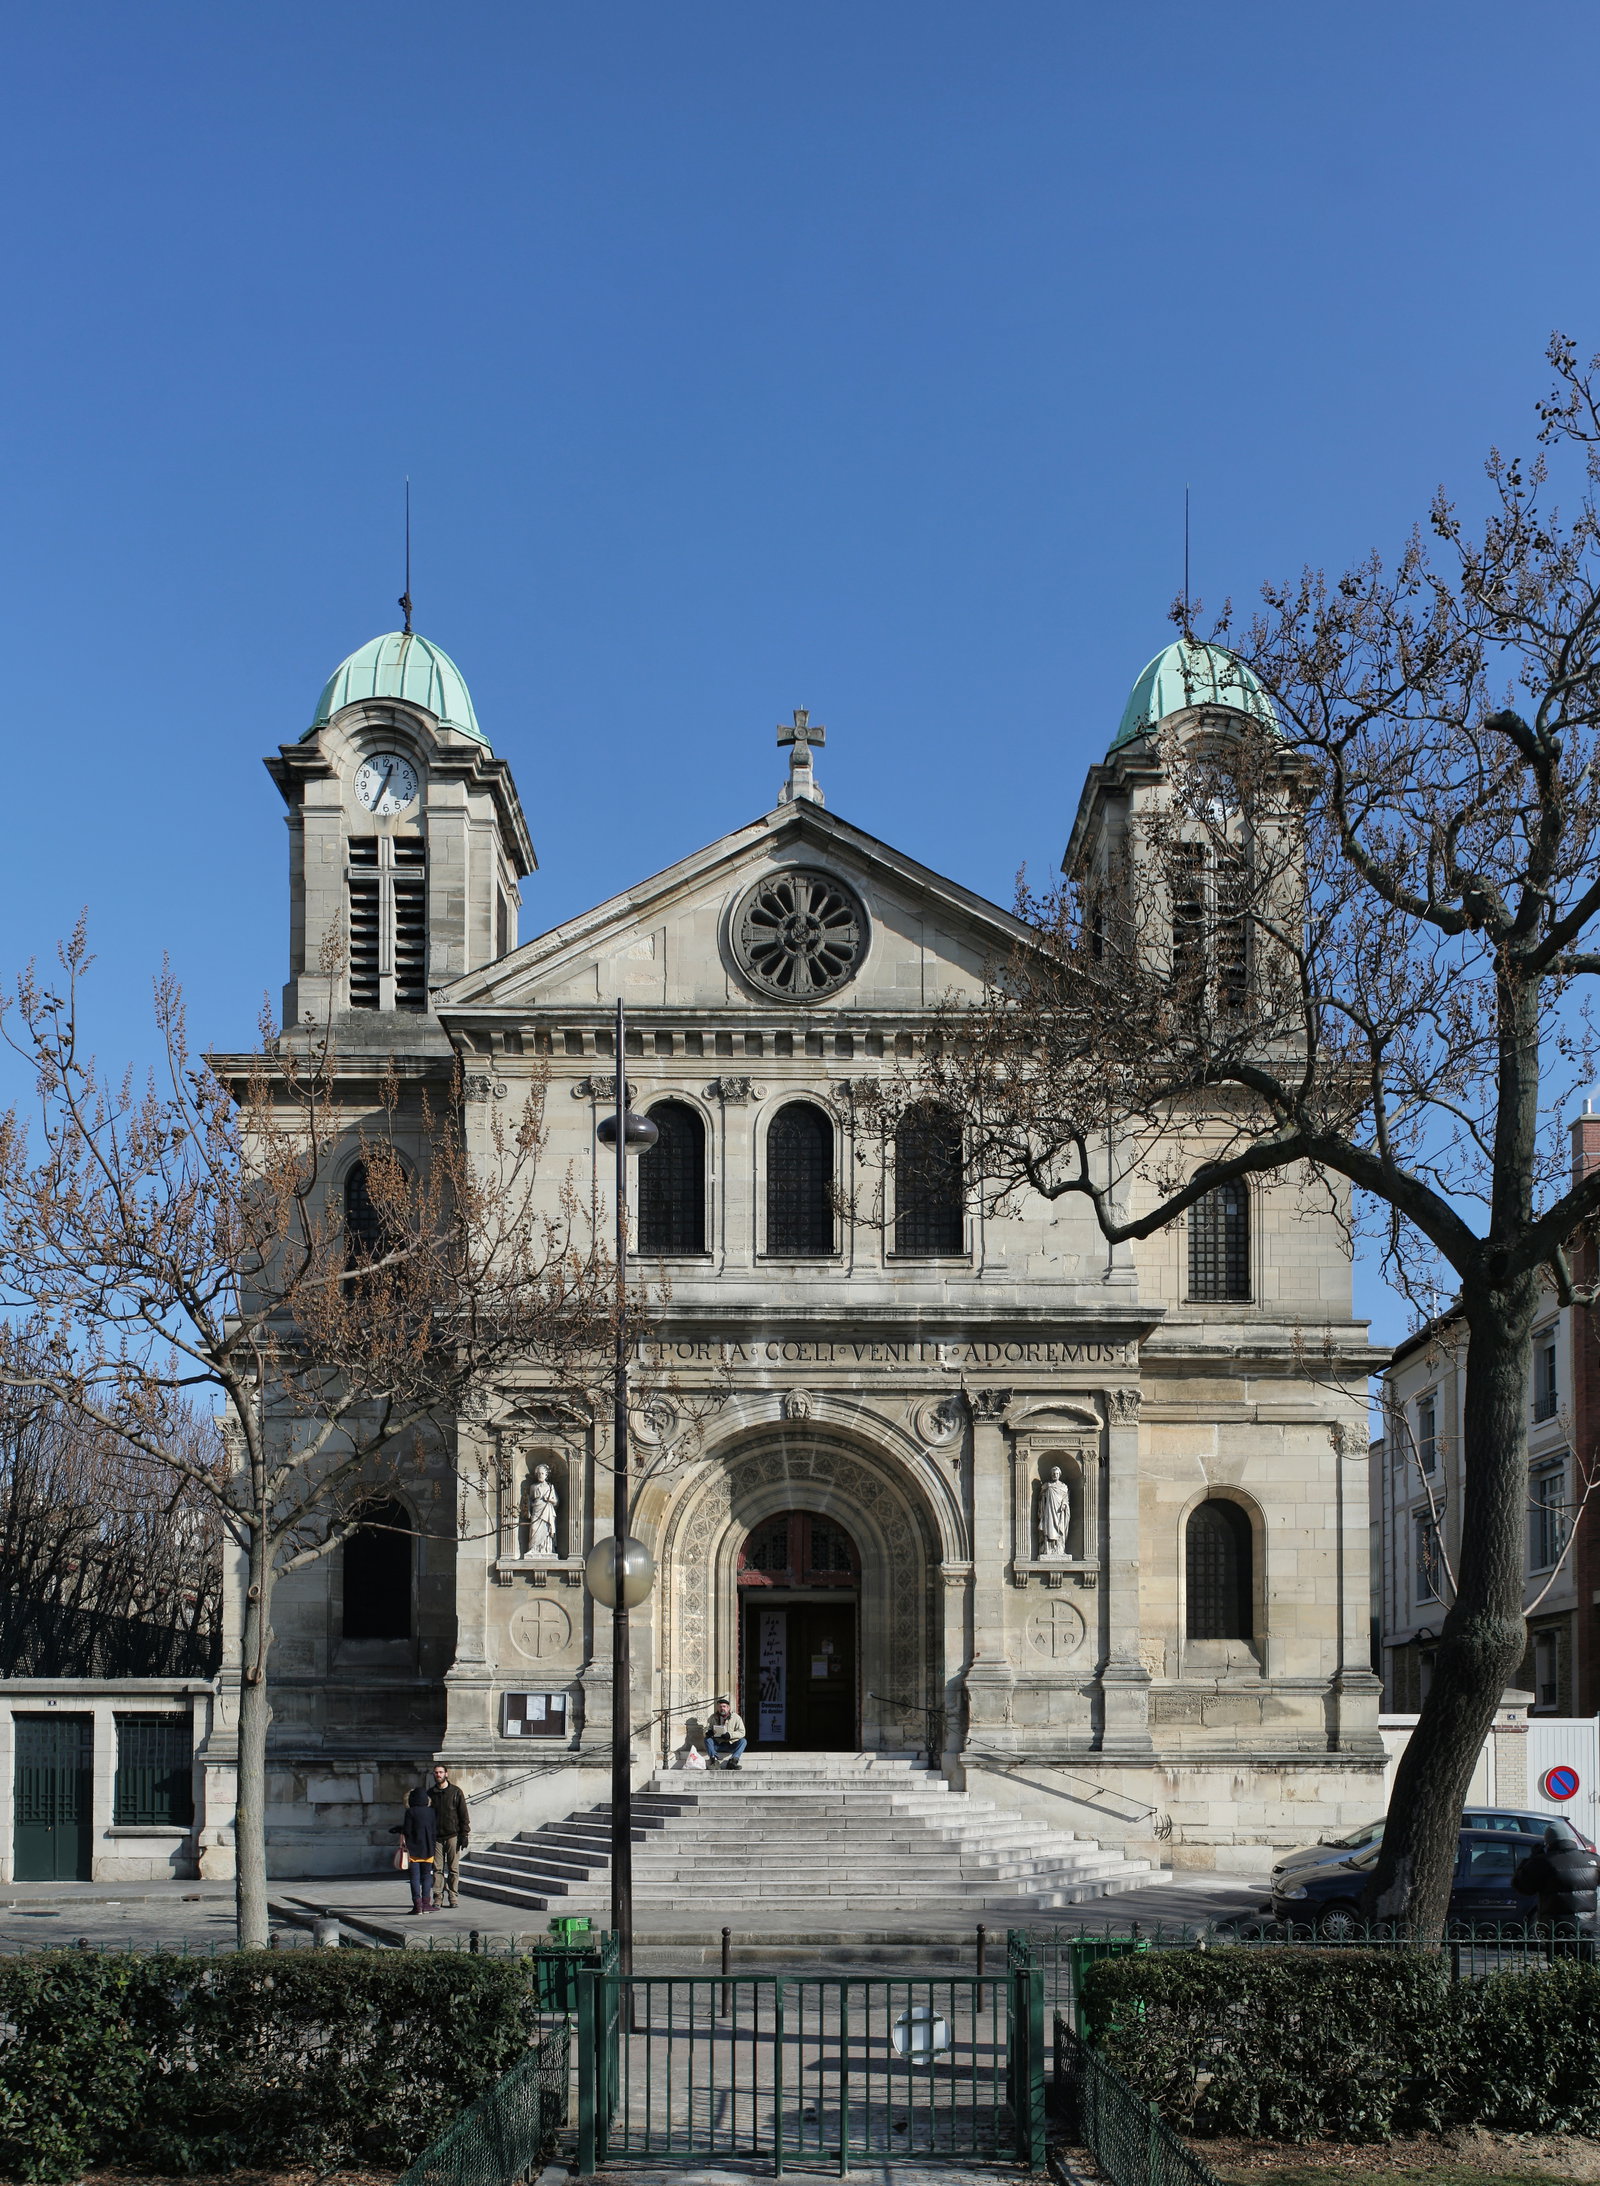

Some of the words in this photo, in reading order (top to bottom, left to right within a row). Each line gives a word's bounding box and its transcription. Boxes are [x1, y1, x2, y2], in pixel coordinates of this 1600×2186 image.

[372, 761, 379, 771] 11
[383, 758, 391, 768] 12
[363, 770, 370, 779] 10
[403, 770, 410, 779] 2
[360, 781, 366, 790] 9
[406, 782, 412, 790] 3
[363, 792, 370, 801] 8
[402, 793, 409, 801] 4
[383, 804, 390, 812] 6
[394, 800, 401, 810] 5
[1218, 808, 1224, 816] 5
[659, 1341, 749, 1361] PORTA
[853, 1342, 948, 1362] VENITE
[964, 1342, 1115, 1362] ADOREMUS
[1063, 1633, 1075, 1644] Ω
